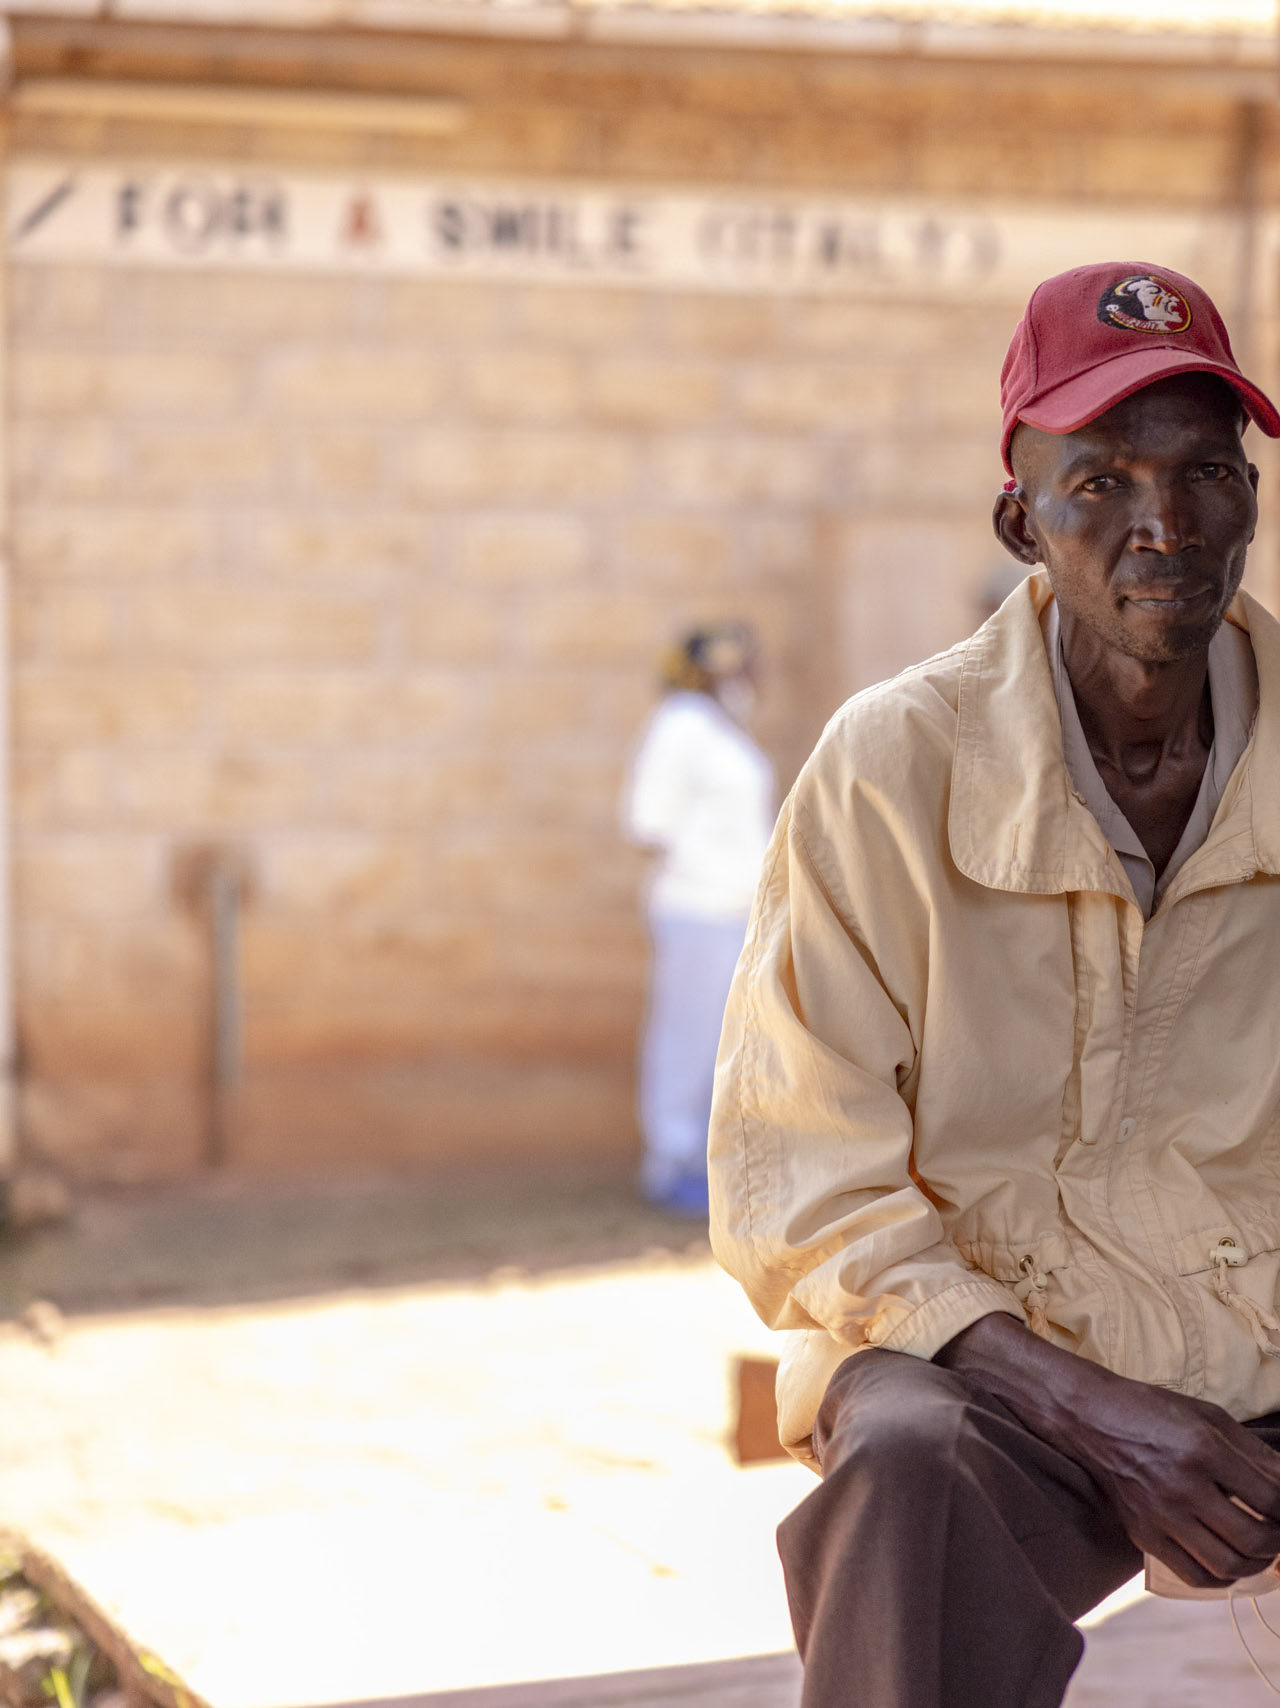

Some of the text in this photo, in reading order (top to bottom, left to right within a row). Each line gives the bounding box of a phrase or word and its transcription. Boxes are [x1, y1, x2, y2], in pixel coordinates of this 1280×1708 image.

[113, 175, 289, 253] FOR
[339, 186, 385, 247] A
[433, 191, 648, 271] SMILE
